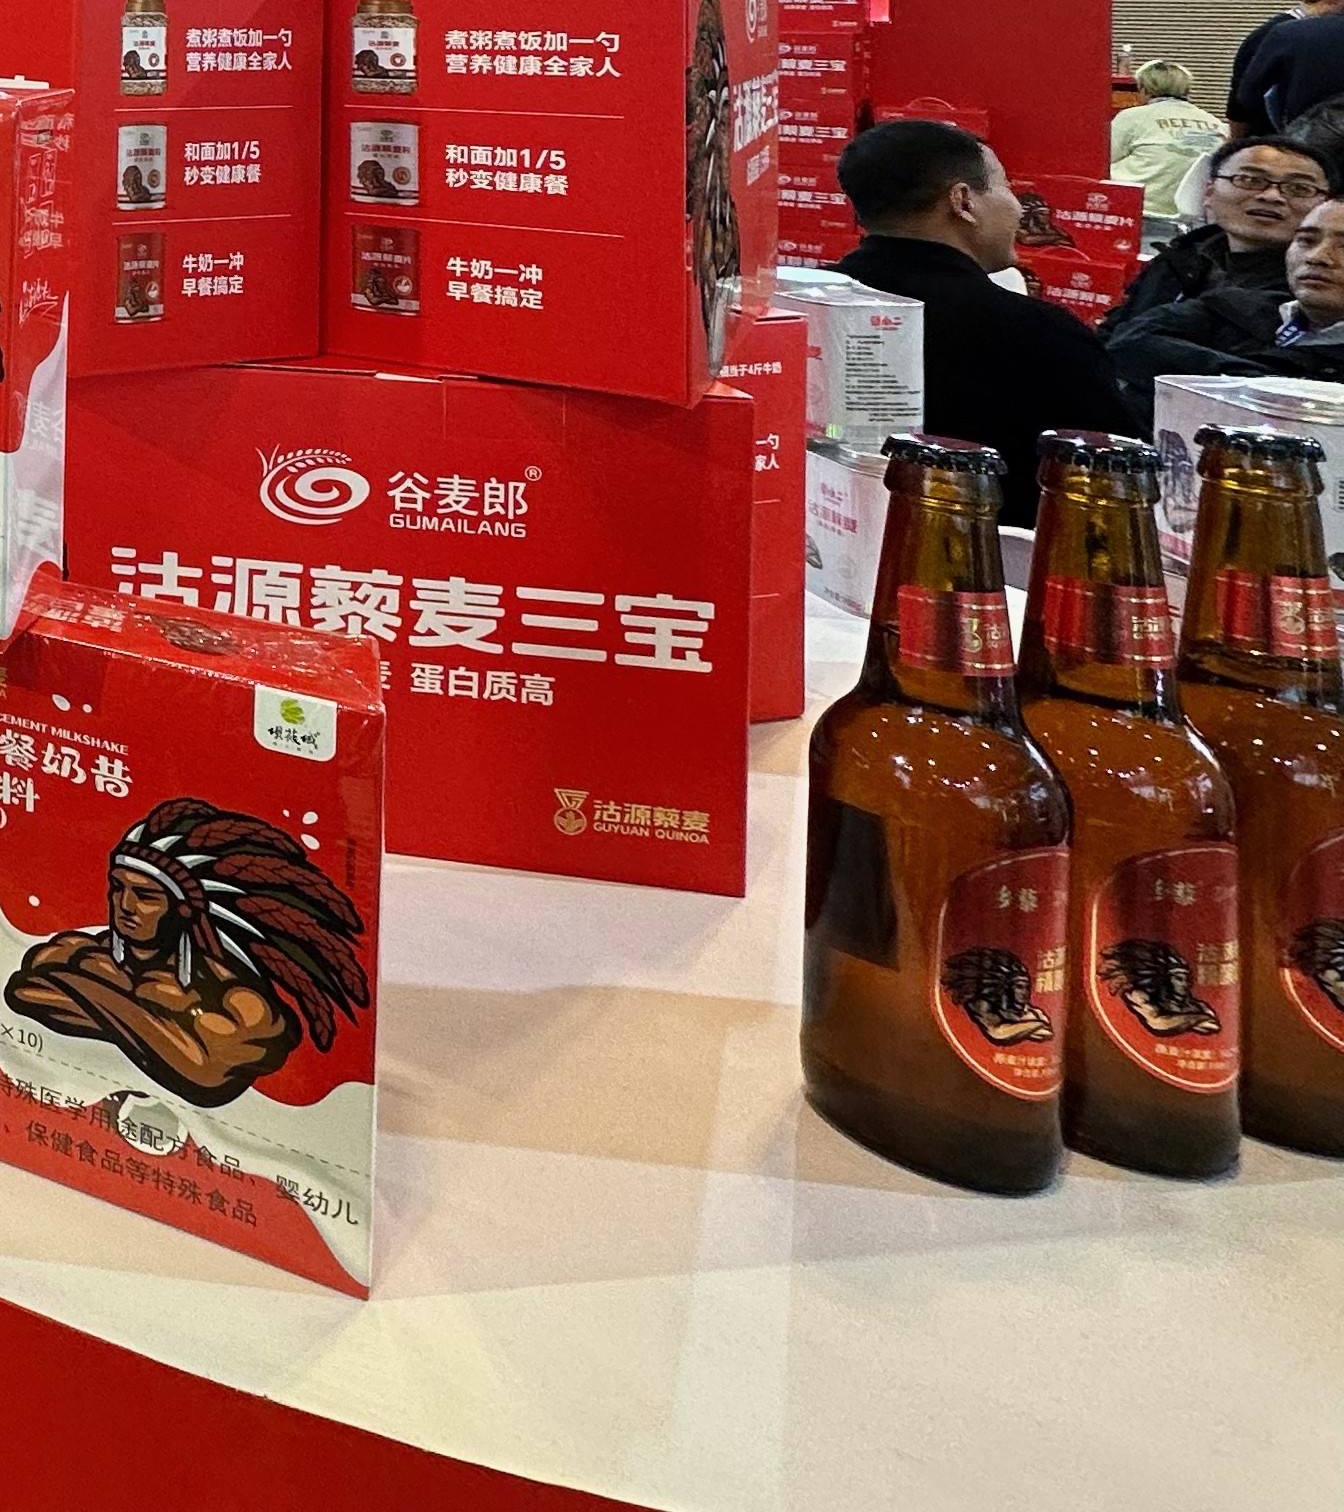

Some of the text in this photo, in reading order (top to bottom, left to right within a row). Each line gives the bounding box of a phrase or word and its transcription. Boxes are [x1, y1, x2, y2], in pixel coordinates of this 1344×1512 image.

[186, 28, 293, 49] 煮粥煮饭加一勺
[445, 30, 621, 53] 煮粥煮饭加一勺
[186, 51, 293, 73] 营养健康全家人
[445, 54, 621, 79] 营养健康全家人
[184, 141, 260, 162] 和面加1/5
[445, 144, 567, 171] 和面加1/5
[184, 164, 261, 186] 秒变健康餐
[445, 170, 569, 196] 秒变健康餐
[182, 252, 244, 274] 牛奶一冲
[446, 257, 544, 283] 牛奶一冲
[181, 275, 244, 298] 早餐搞定
[446, 282, 544, 309] 早餐搞定
[387, 470, 529, 521] 谷麦郎
[389, 513, 527, 539] GUMAILANG
[111, 545, 715, 674] 沽源藜麦三宝
[411, 663, 555, 707] 蛋白质高
[51, 724, 130, 756] MILKSHAKE
[593, 799, 711, 835] 沽源藜麦
[593, 822, 711, 845] GUYUAN QUINOA
